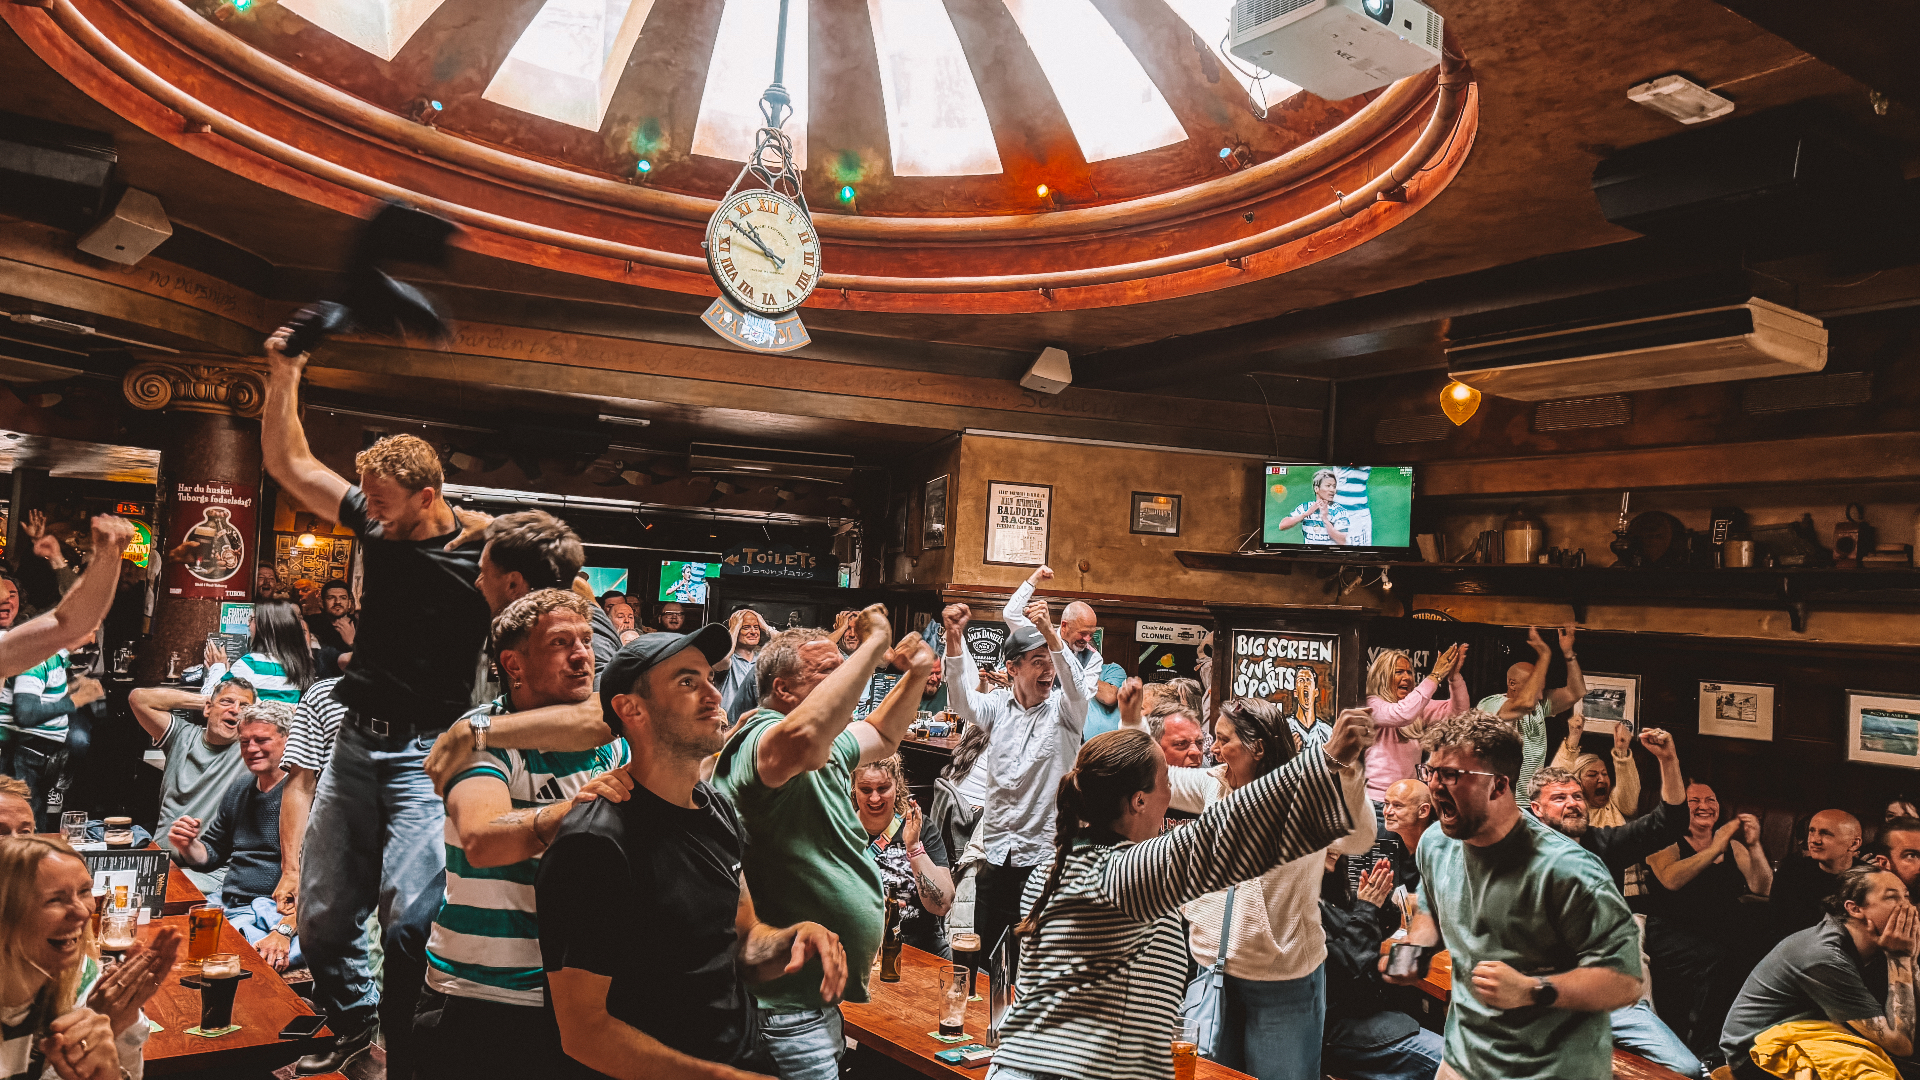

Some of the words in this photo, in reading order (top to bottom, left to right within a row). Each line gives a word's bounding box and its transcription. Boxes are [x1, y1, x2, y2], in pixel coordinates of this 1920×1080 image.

[1333, 49, 1356, 61] NEC
[734, 201, 753, 219] XI
[757, 198, 780, 215] XII
[178, 483, 193, 493] Har
[194, 484, 205, 493] du
[206, 485, 233, 496] husket
[177, 492, 209, 504] Tuborgs
[997, 505, 1044, 518] BALDOYLE
[1001, 516, 1039, 526] RACES
[742, 565, 814, 579] Downstairs
[1141, 632, 1173, 641] CLONMEL
[1196, 630, 1207, 640] 17
[1237, 634, 1266, 656] BIG
[1266, 637, 1333, 663] SCREEN
[1240, 657, 1275, 679] LIVE
[1233, 666, 1296, 698] SPORTS
[1870, 711, 1909, 719] NOVEMBER
